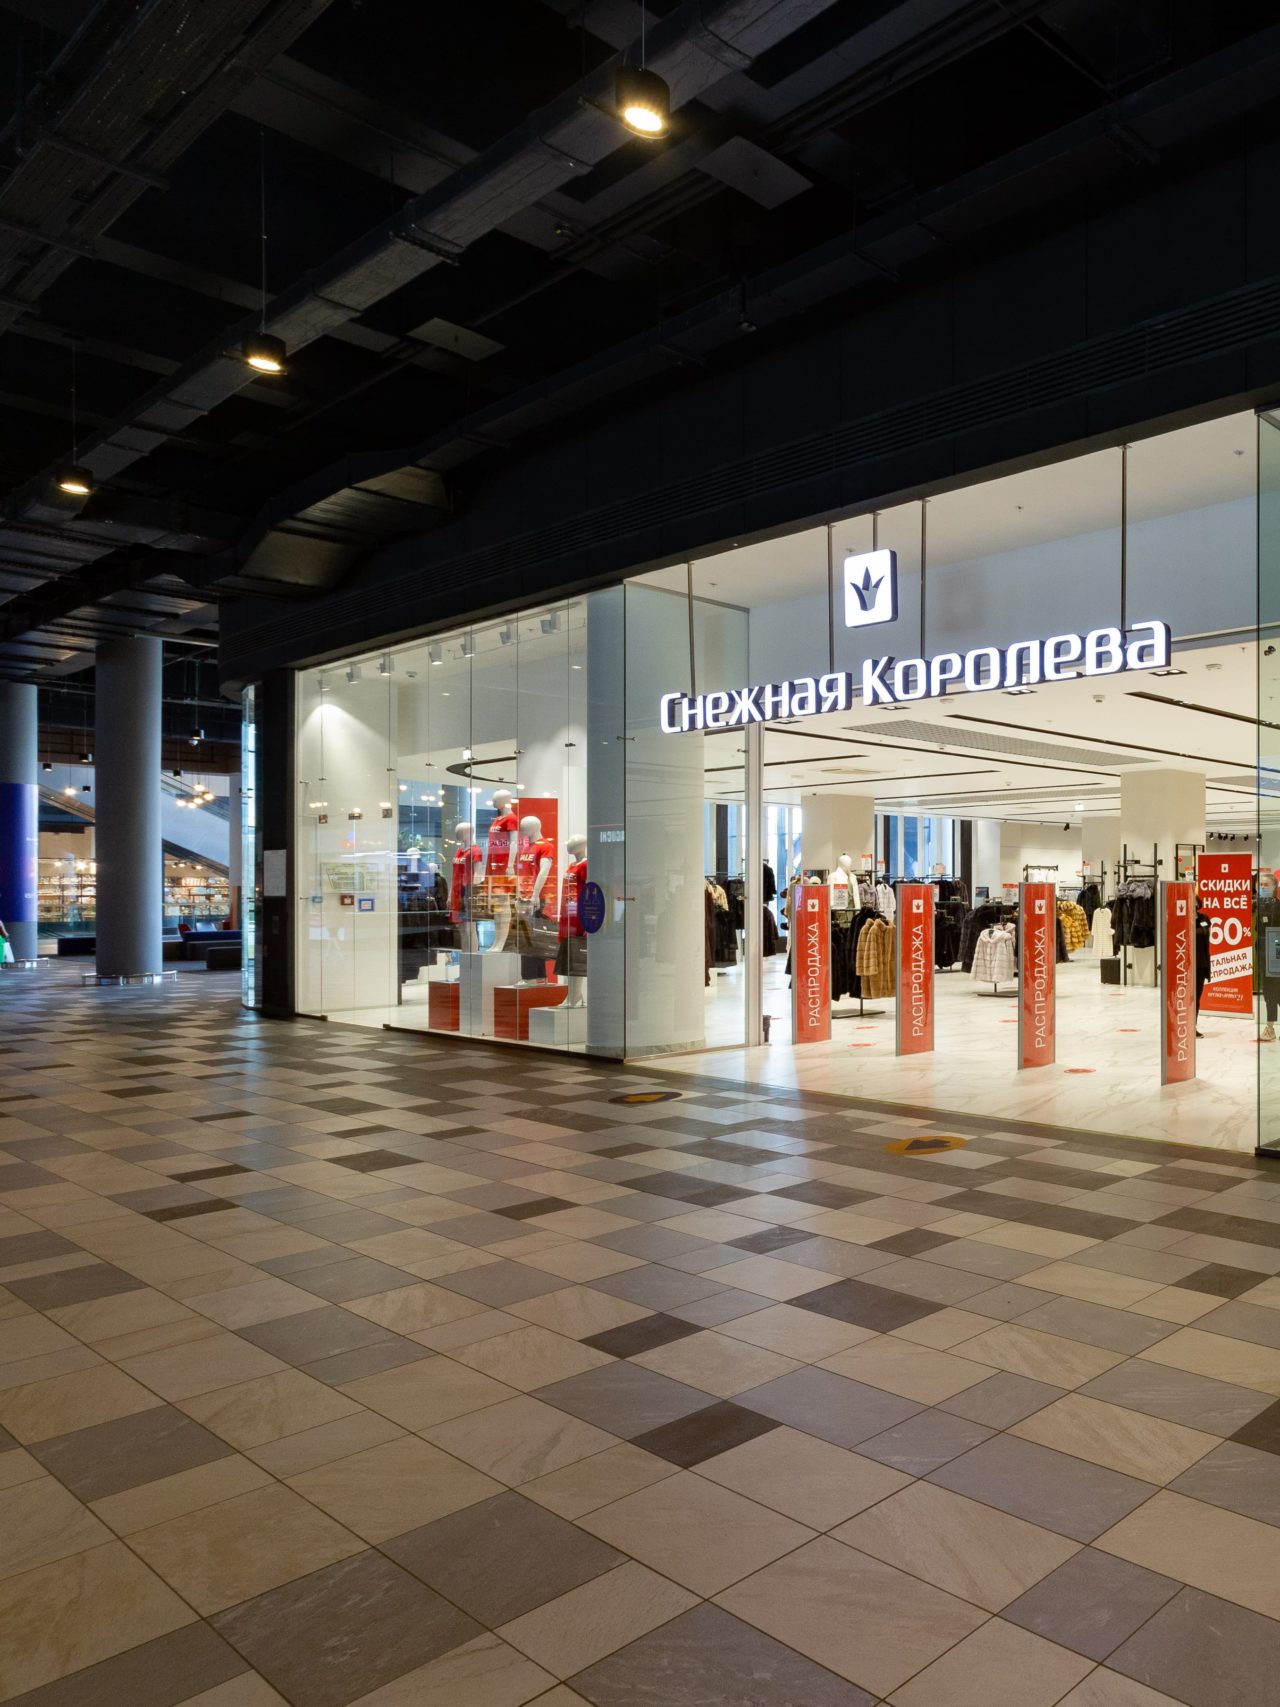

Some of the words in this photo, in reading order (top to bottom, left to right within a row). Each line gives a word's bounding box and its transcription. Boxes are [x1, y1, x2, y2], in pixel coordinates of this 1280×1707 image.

[519, 853, 535, 862] ALE
[1200, 879, 1251, 893] СКИДКИ
[1203, 897, 1220, 909] НА
[1223, 894, 1248, 909] ВСЁ
[1210, 952, 1248, 968] ТАЛЬНАЯ
[808, 922, 821, 1027] РАСПРОДАЖА
[1210, 962, 1253, 979] СПРОДАЖА
[912, 924, 925, 1037] РАСПРОДАЖА
[1034, 927, 1047, 1048] РАСПРОДАЖА
[1176, 929, 1188, 1062] РАСПРОДАЖА
